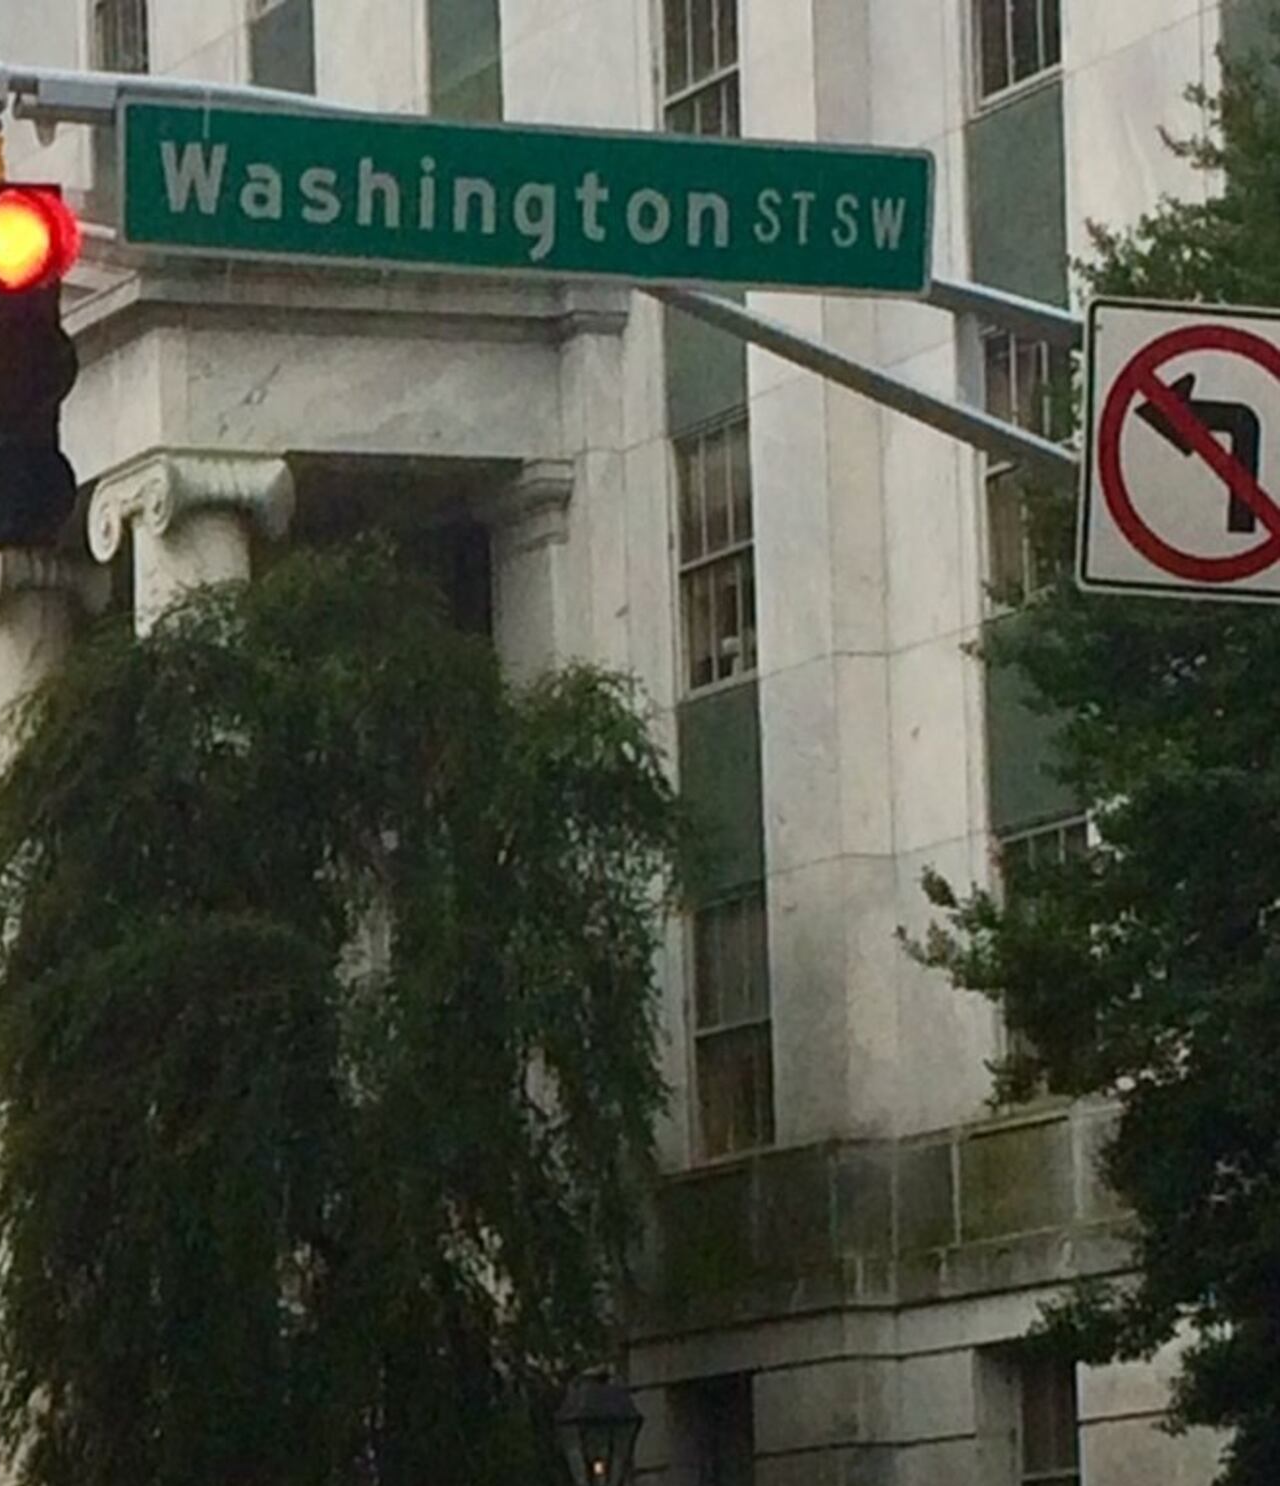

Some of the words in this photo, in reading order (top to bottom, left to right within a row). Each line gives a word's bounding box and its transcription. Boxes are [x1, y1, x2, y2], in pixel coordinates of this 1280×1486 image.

[160, 140, 729, 260] Washington
[753, 188, 816, 245] ST
[831, 193, 906, 249] SW
